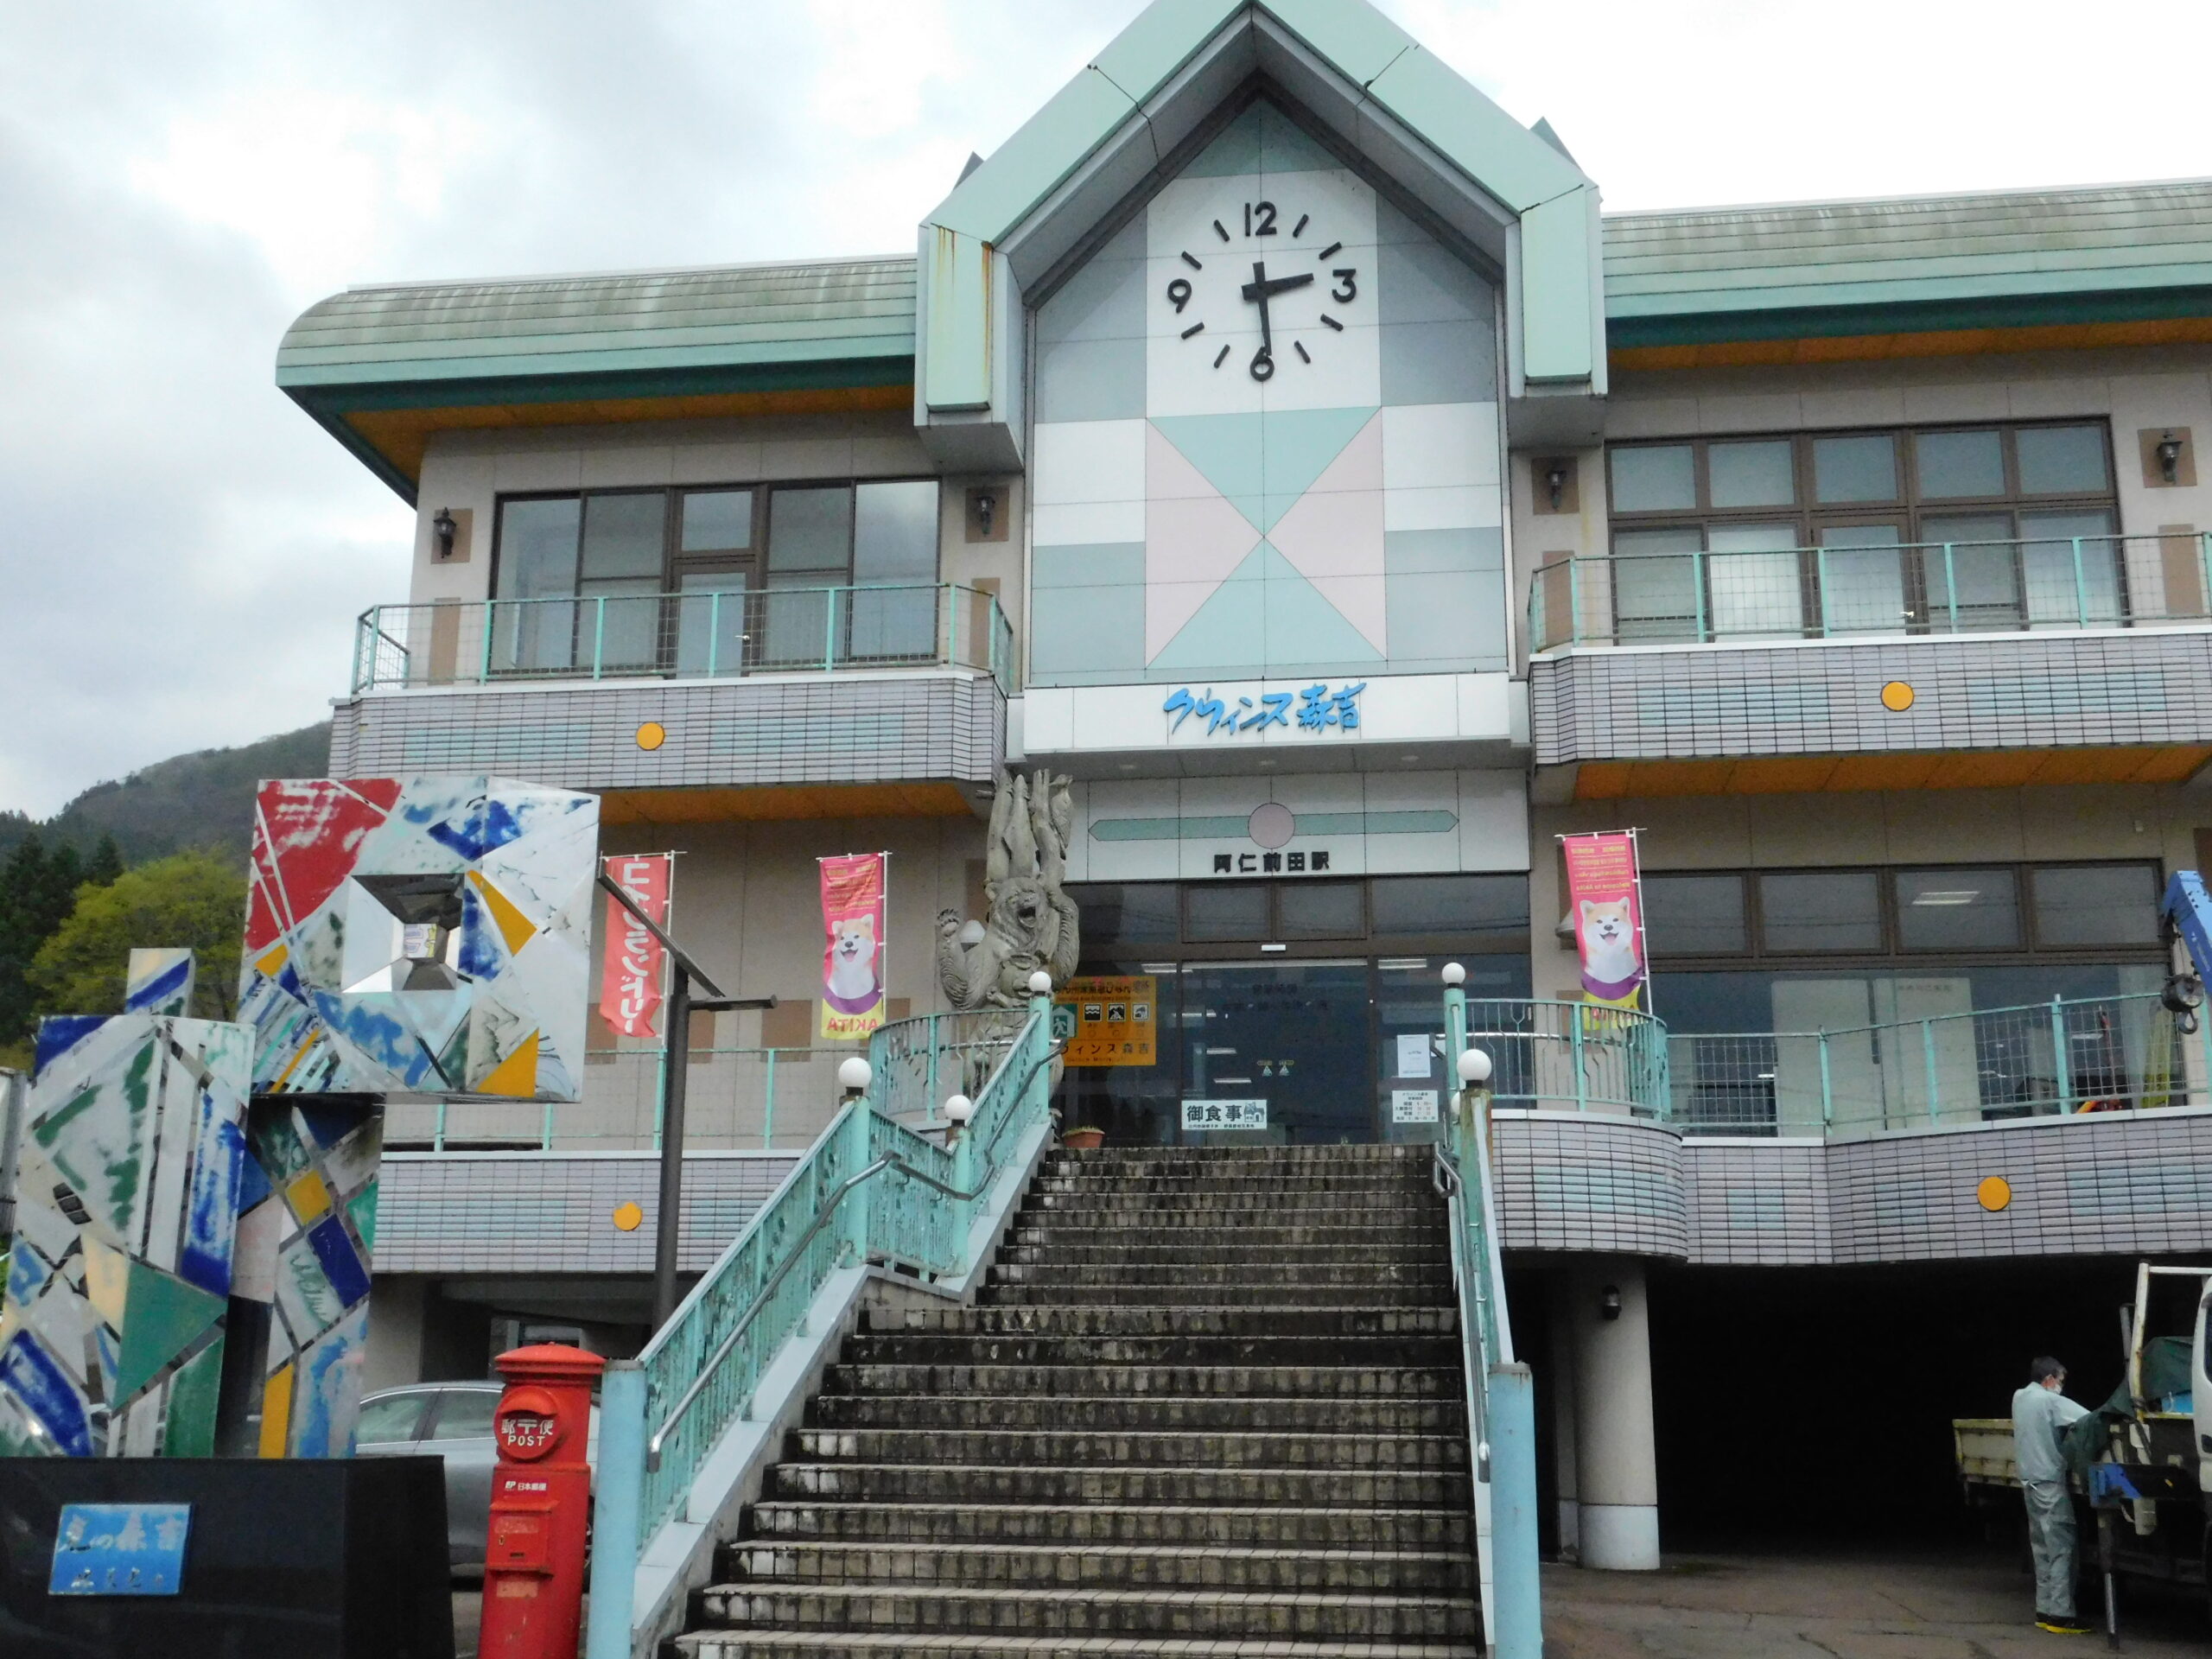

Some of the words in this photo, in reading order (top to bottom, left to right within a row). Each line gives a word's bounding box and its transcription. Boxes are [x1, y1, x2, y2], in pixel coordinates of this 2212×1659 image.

[1244, 200, 1277, 237] 12
[1167, 278, 1192, 314] 9
[1332, 268, 1357, 303] 3
[1249, 346, 1274, 382] 6
[1213, 851, 1330, 874] 阿仁前田駅
[1186, 1105, 1243, 1122] 御食事
[507, 1435, 545, 1446] POST
